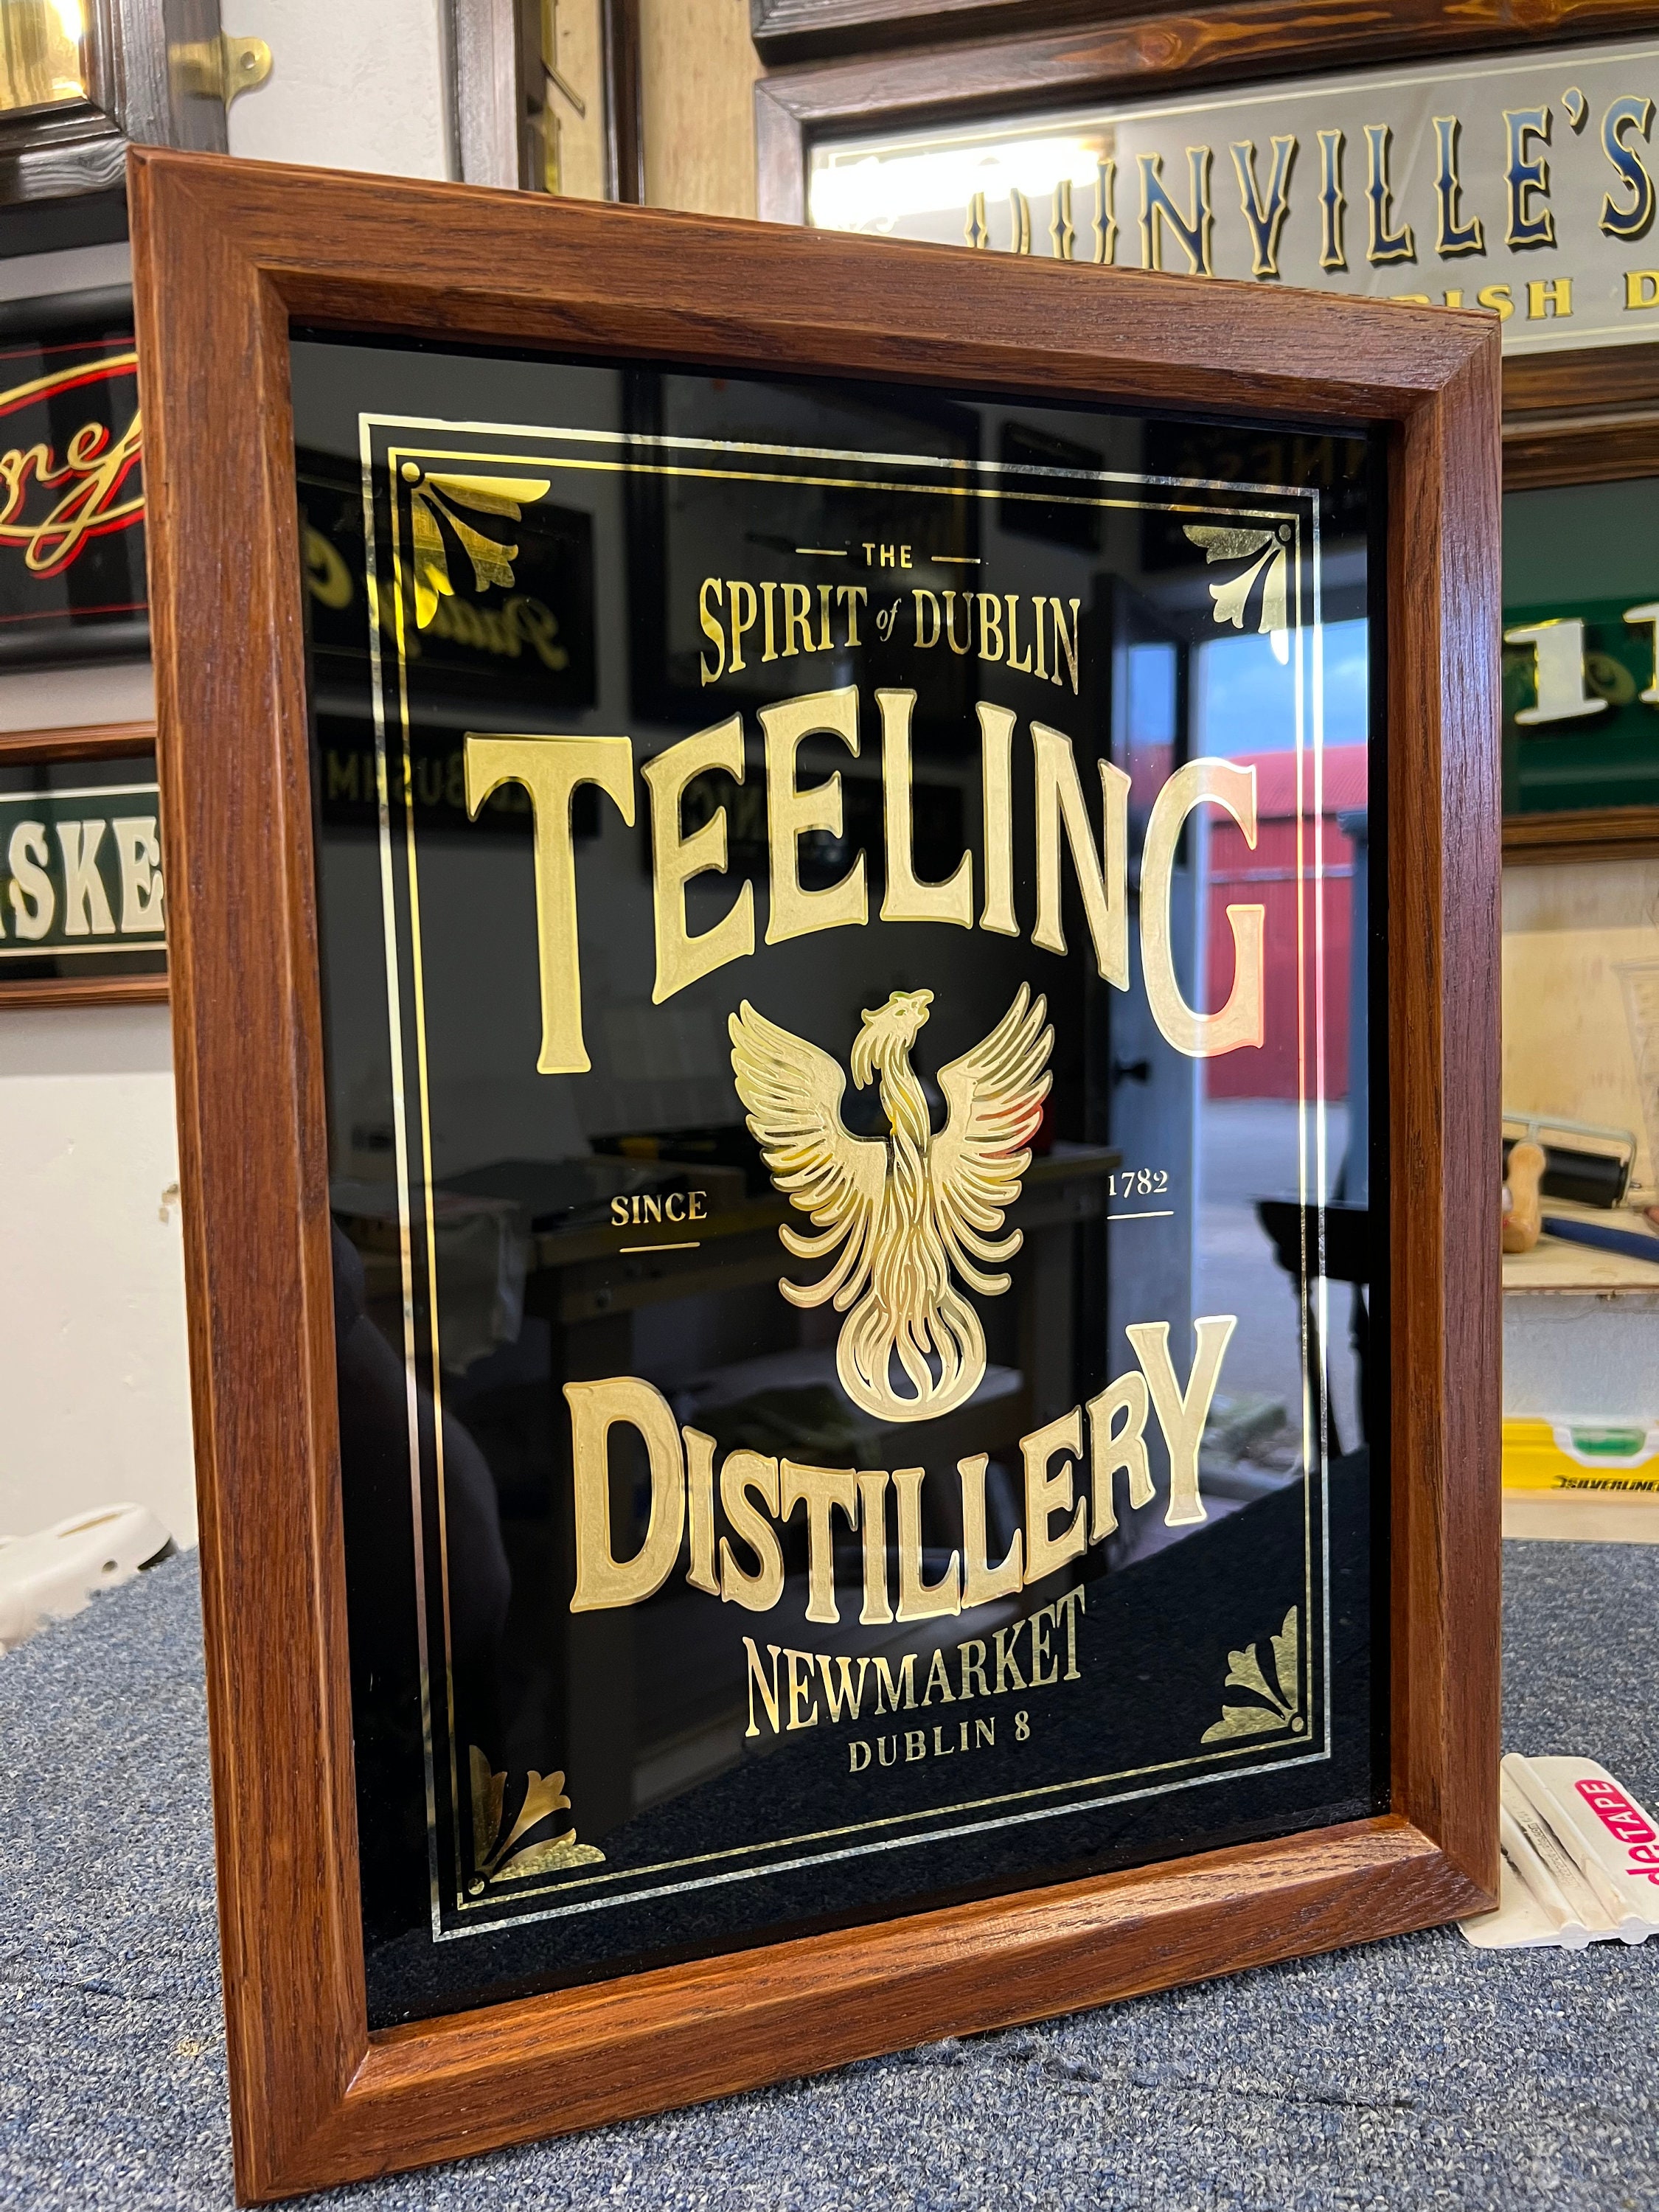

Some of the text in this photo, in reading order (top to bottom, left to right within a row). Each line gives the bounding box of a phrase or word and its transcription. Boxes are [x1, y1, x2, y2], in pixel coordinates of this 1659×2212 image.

[863, 543, 914, 569] THE
[700, 577, 1081, 695] SPIRIT of DUBLIN
[0, 815, 166, 941] SKE
[464, 684, 1265, 1076] TEELING
[609, 1189, 709, 1228] SINCE
[1107, 1167, 1170, 1200] 1782
[562, 1315, 1239, 1625] DISTILLERY
[742, 1585, 1087, 1738] NEWMARKET
[848, 1711, 1032, 1773] DUBLIN 8
